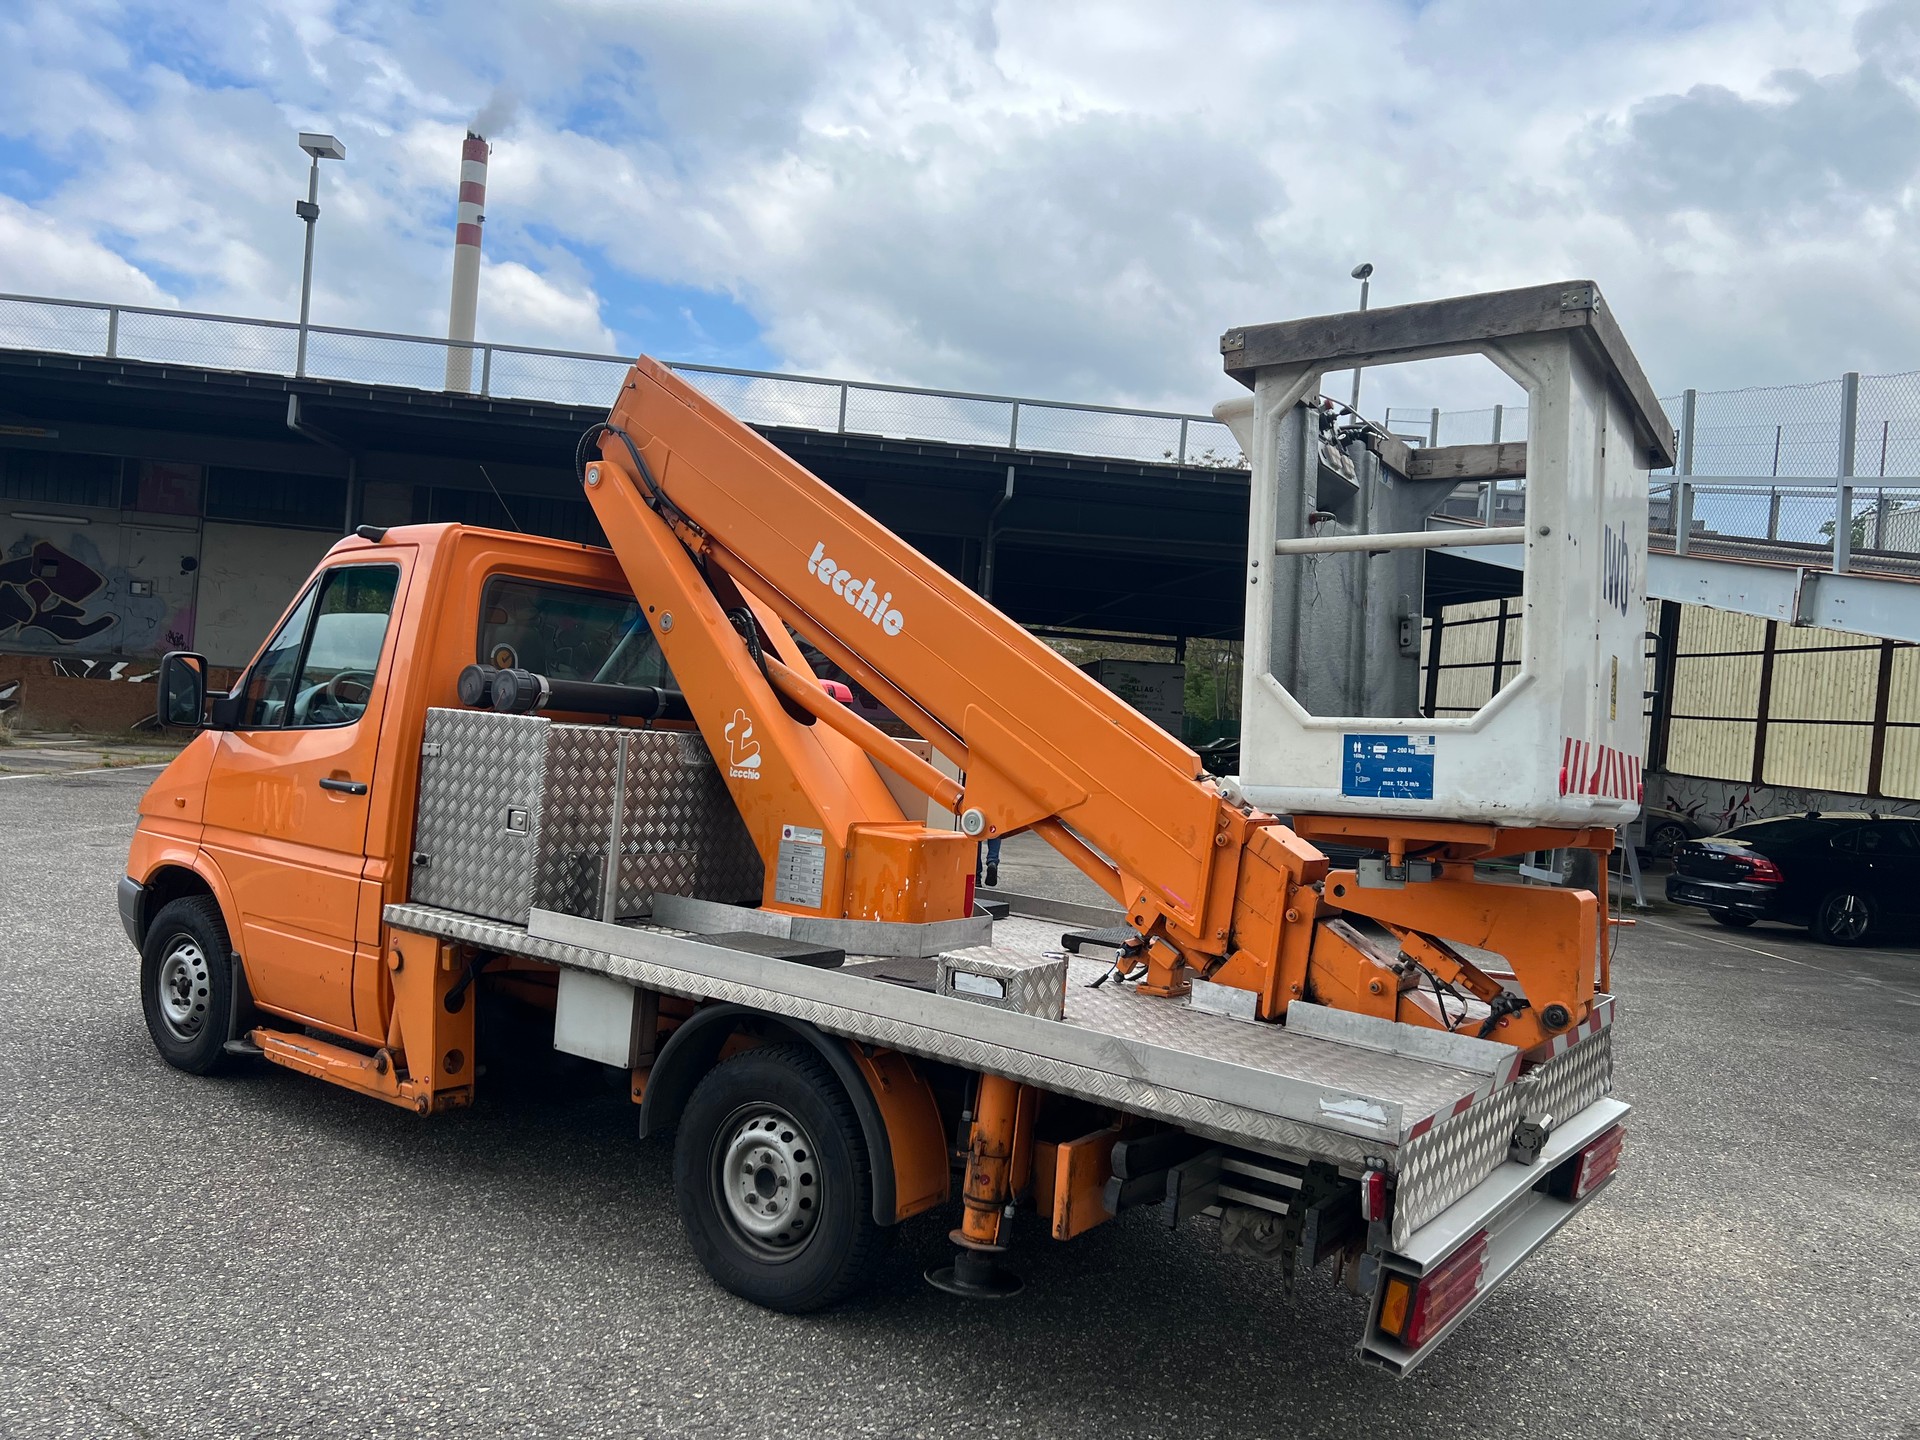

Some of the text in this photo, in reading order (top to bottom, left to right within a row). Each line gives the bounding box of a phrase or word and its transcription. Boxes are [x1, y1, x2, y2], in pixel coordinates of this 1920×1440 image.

[807, 540, 904, 637] tecchio
[1408, 747, 1415, 755] kg
[729, 766, 760, 780] tecchio
